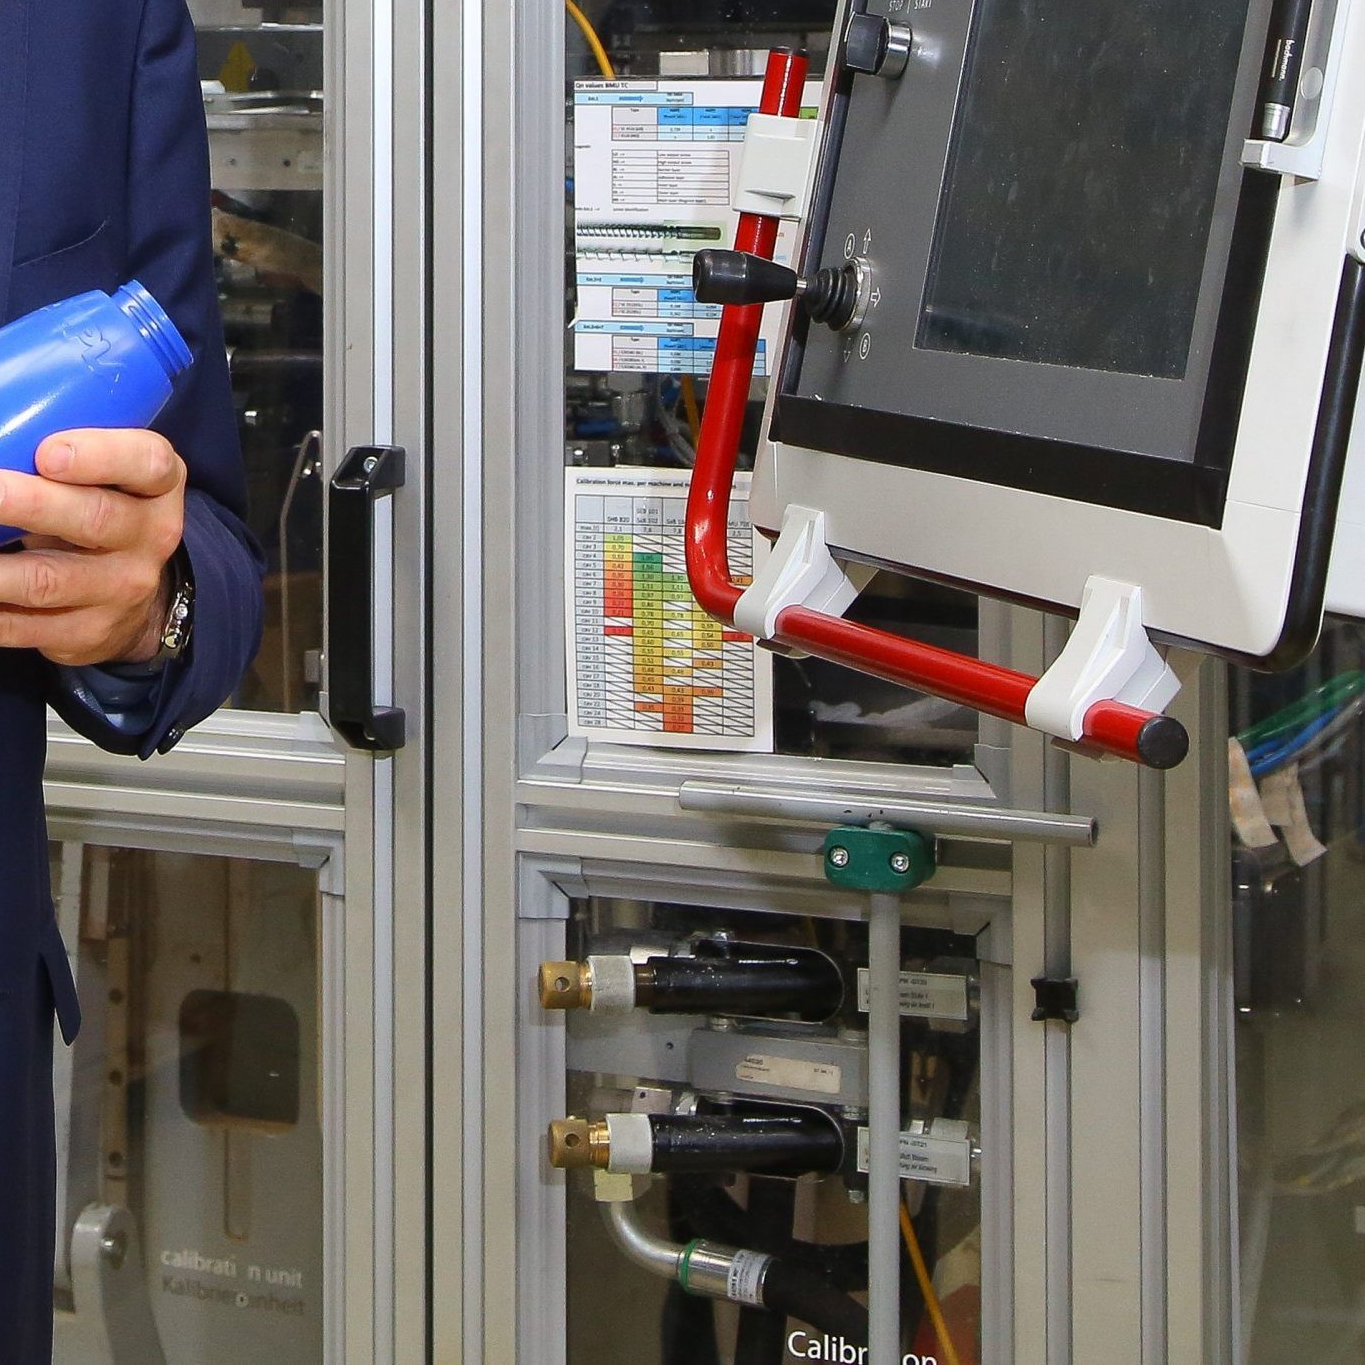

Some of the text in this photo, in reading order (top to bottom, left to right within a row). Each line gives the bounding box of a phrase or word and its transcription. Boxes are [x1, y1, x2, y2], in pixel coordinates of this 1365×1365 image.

[889, 0, 904, 12] STOP
[161, 1250, 261, 1282] calibratin
[787, 1331, 937, 1365] Calibro
